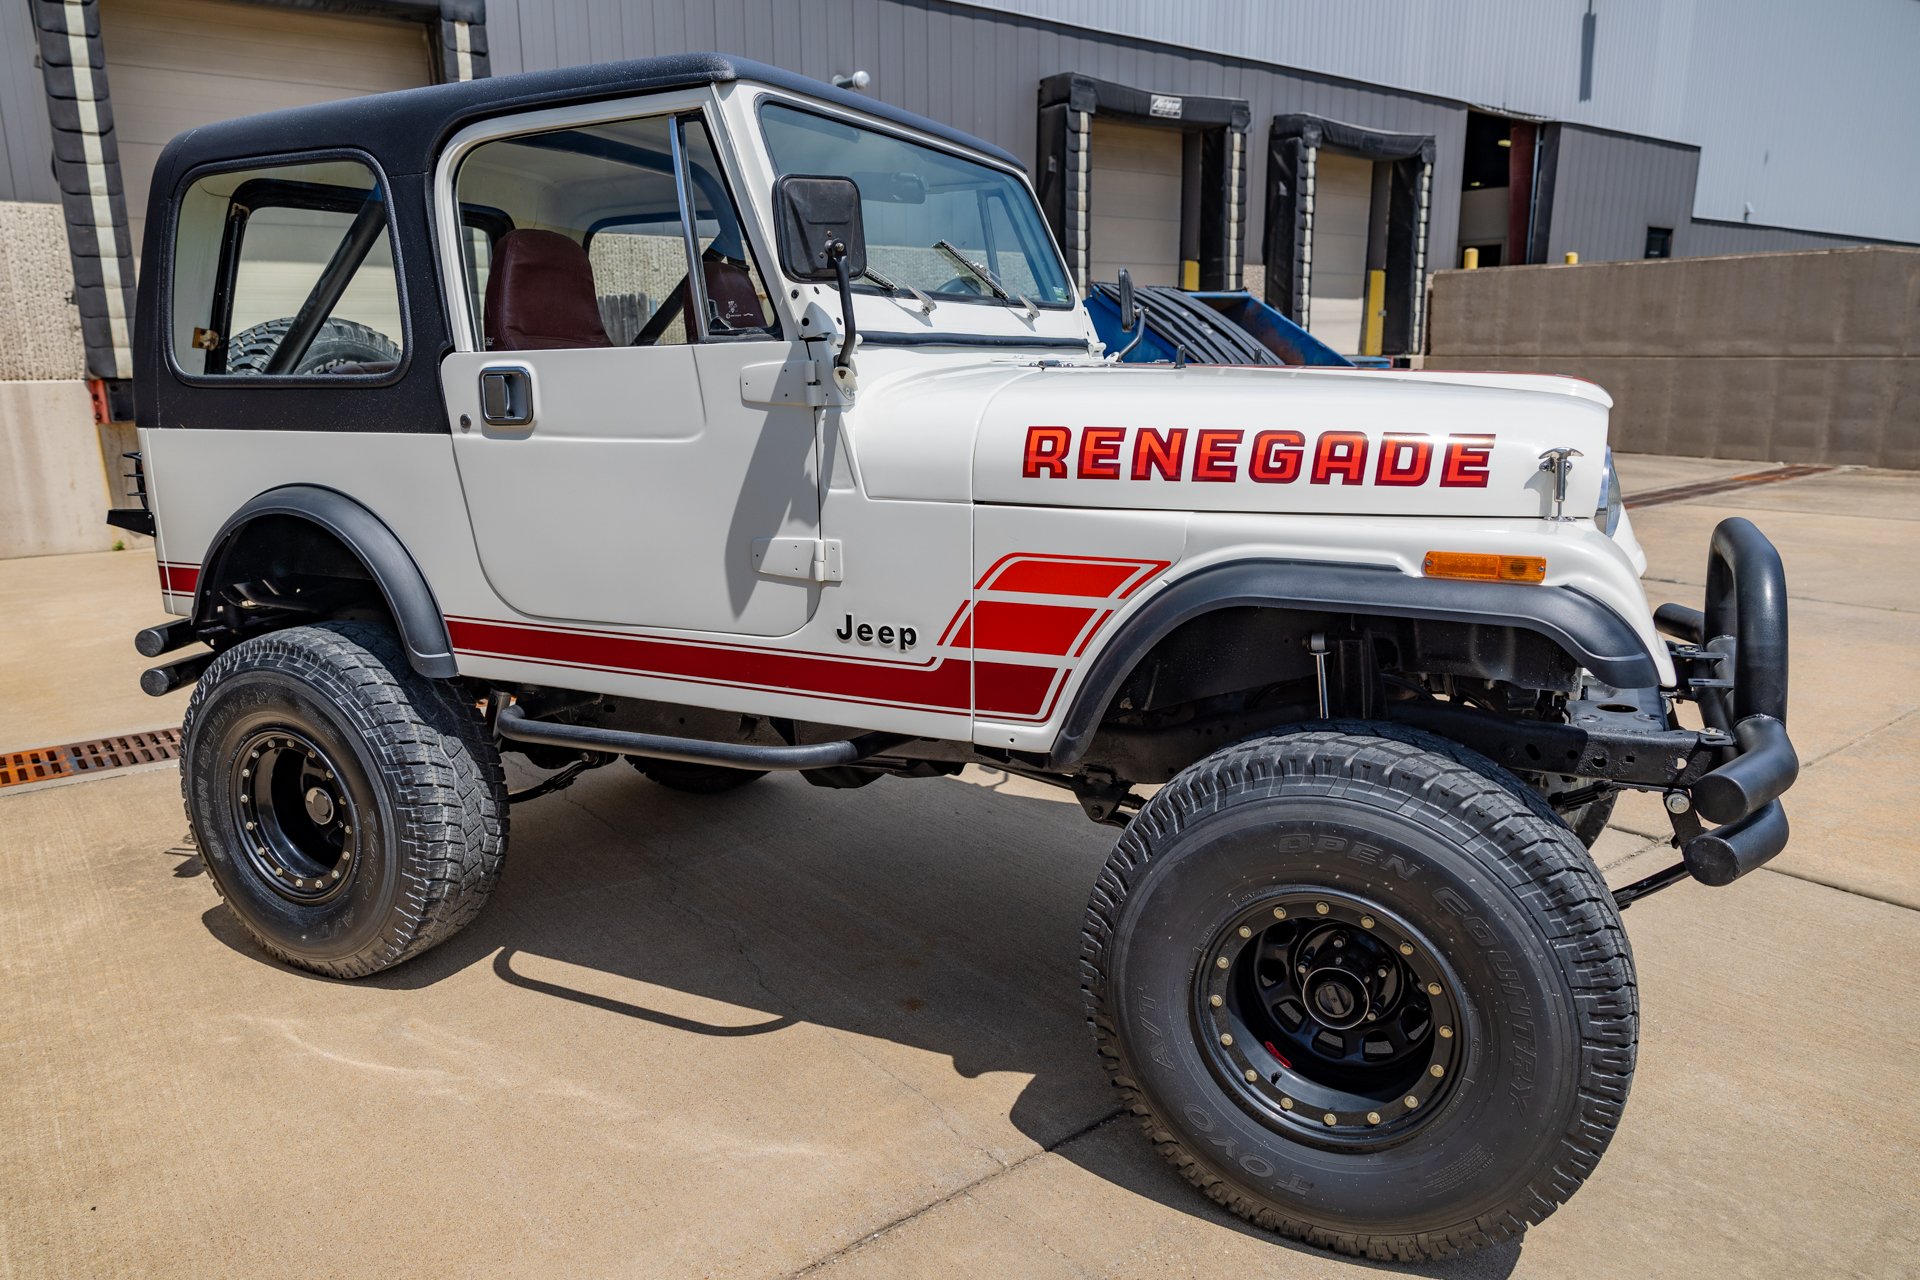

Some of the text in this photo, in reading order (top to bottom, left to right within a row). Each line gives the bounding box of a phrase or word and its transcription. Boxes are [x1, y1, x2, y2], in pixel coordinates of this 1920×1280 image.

[1022, 426, 1496, 488] RENEGADE
[836, 613, 917, 651] Jeep
[1278, 833, 1421, 880] OPEN
[1432, 887, 1537, 1119] COUNTRY
[1183, 1103, 1314, 1197] TOYO
